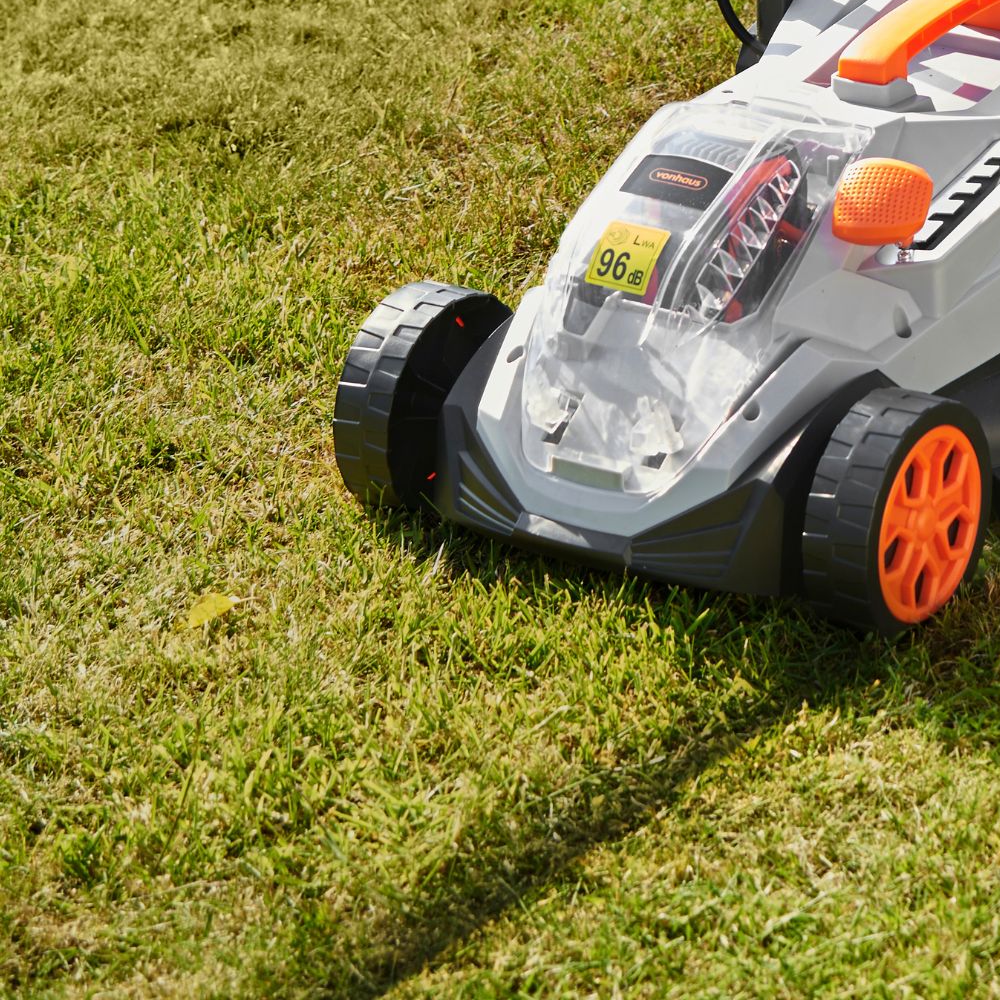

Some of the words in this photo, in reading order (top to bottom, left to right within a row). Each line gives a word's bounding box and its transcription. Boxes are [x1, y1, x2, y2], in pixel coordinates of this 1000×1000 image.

[656, 171, 702, 187] vonhaus
[596, 248, 630, 280] 96
[627, 269, 644, 286] dB
